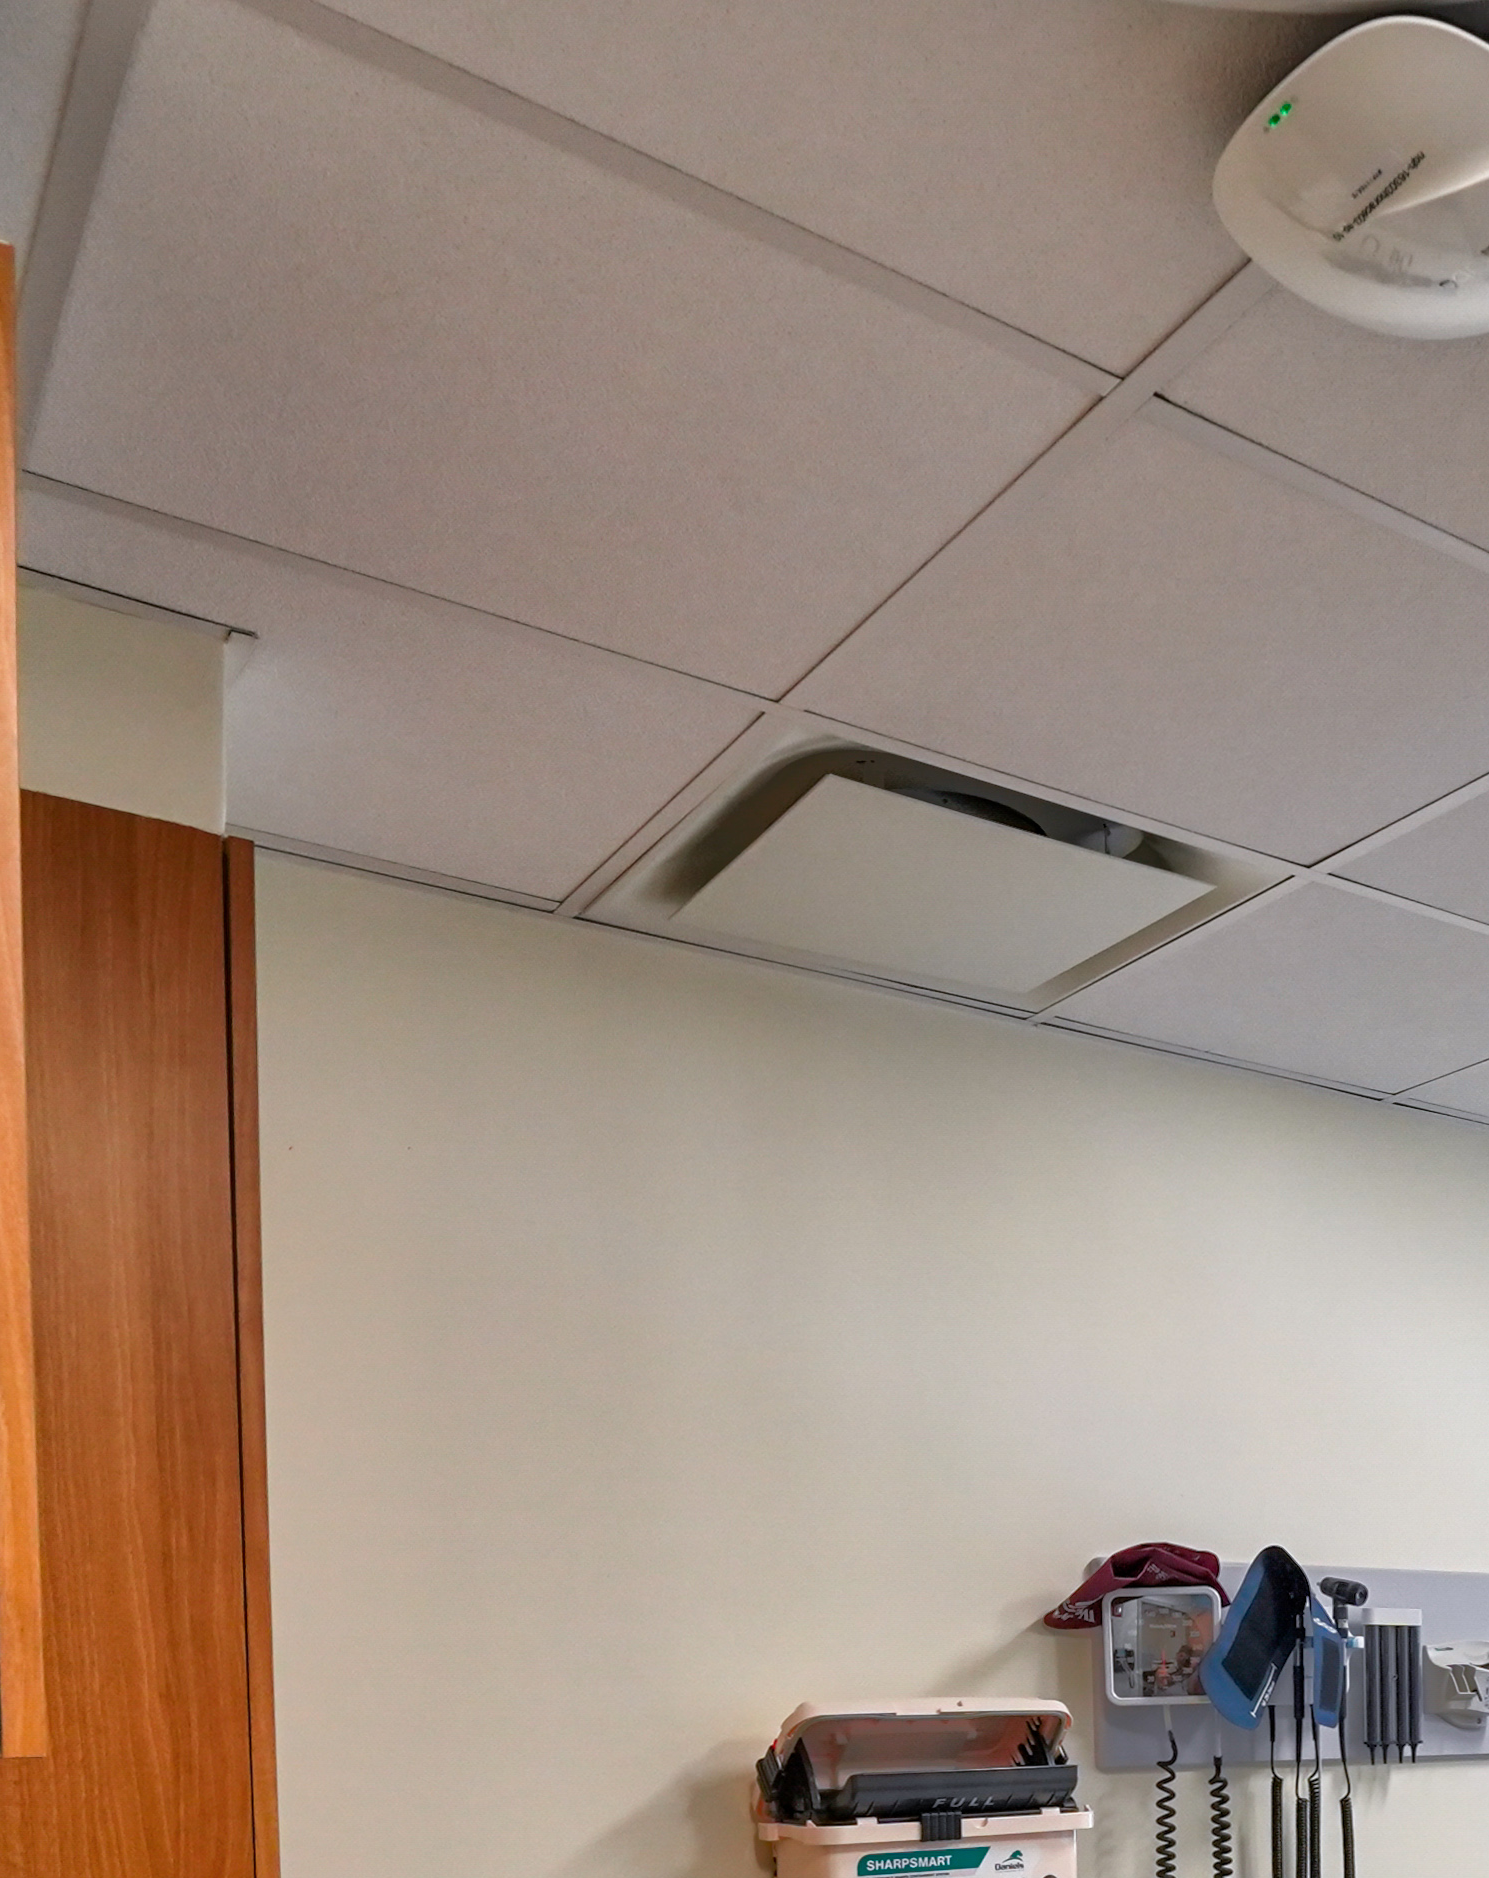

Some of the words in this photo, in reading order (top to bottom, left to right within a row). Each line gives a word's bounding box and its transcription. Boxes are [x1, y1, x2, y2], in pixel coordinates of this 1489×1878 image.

[932, 1796, 995, 1811] FULL
[866, 1855, 953, 1872] SHARPSMART
[995, 1861, 1025, 1871] Daniels
